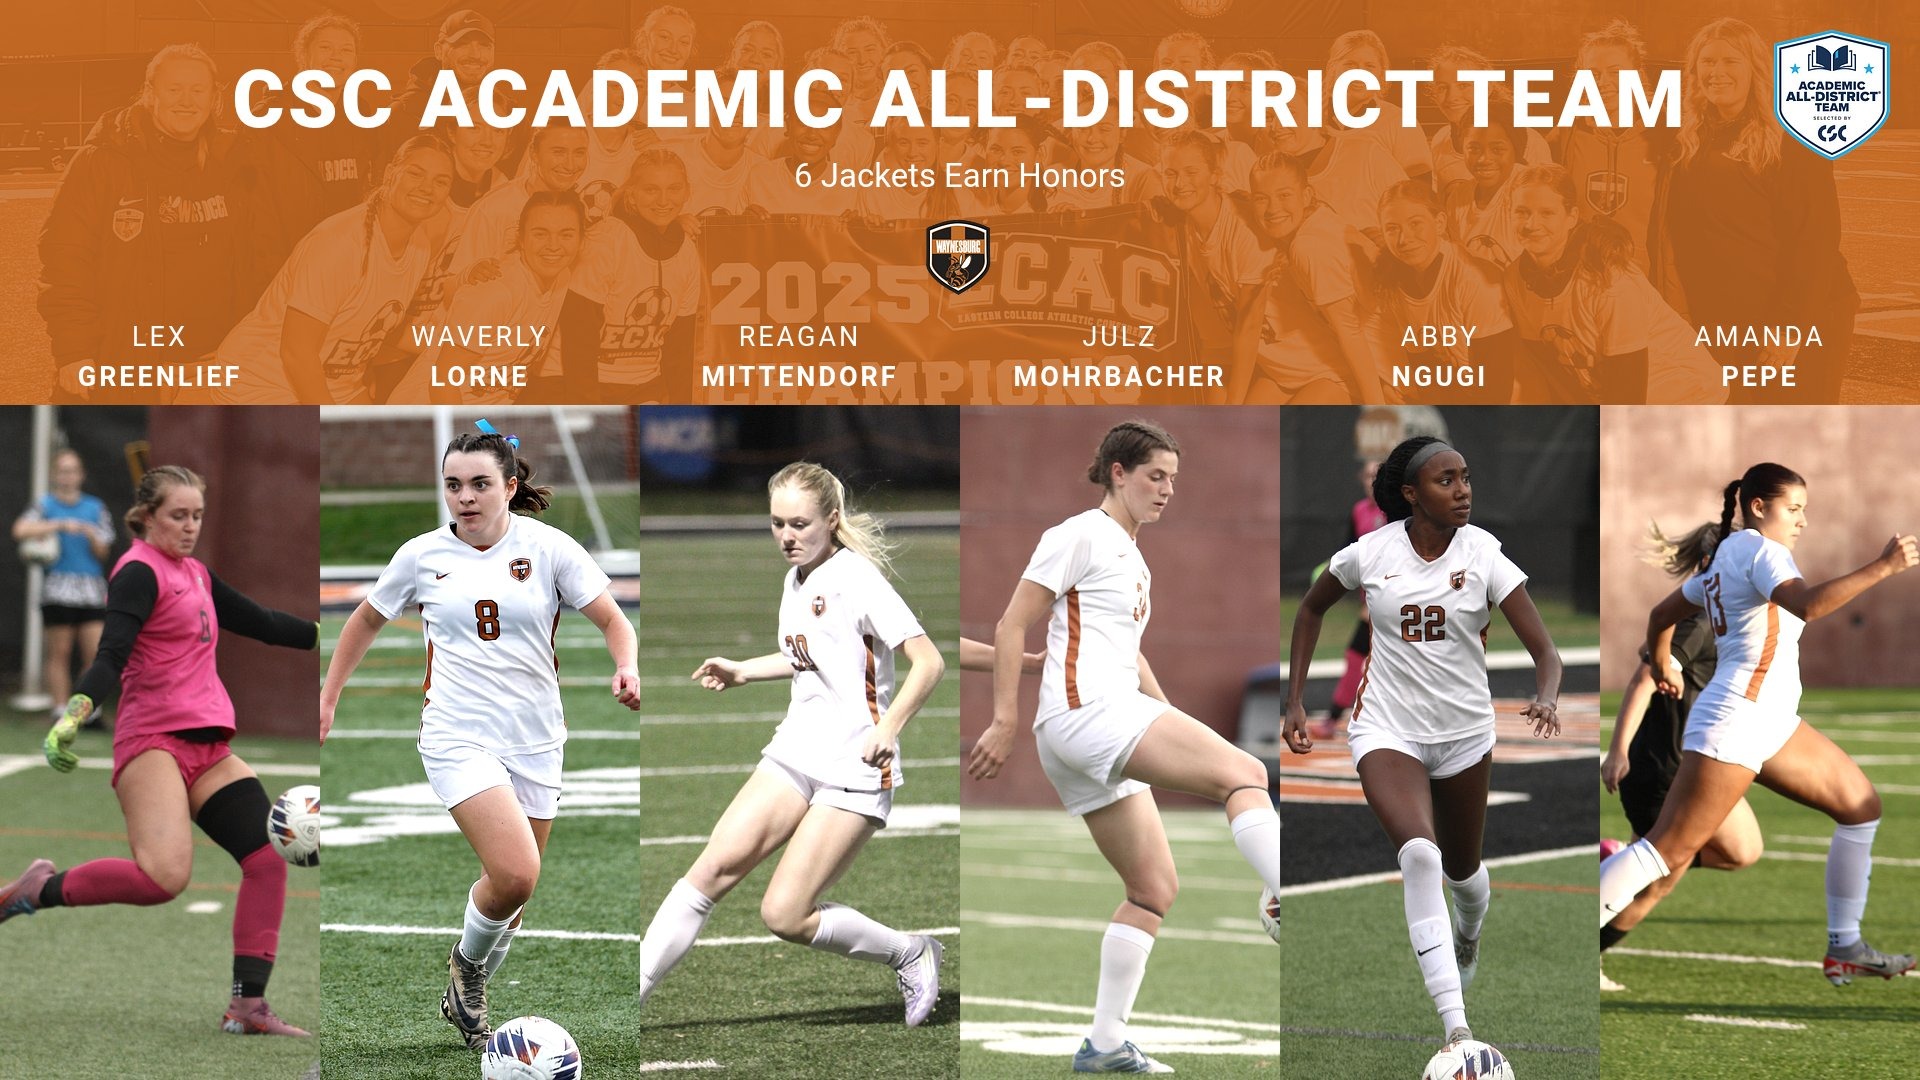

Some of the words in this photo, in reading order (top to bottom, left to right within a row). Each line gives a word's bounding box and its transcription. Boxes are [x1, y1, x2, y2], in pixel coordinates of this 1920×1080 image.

[711, 261, 930, 325] 2025
[958, 310, 1001, 323] EASTERN
[1003, 310, 1044, 321] COLLEGE
[1046, 311, 1094, 326] ATHLETIC
[1096, 318, 1158, 344] CONFERENE
[475, 599, 501, 641] 8
[1400, 604, 1446, 643] 22
[785, 634, 819, 672] 30
